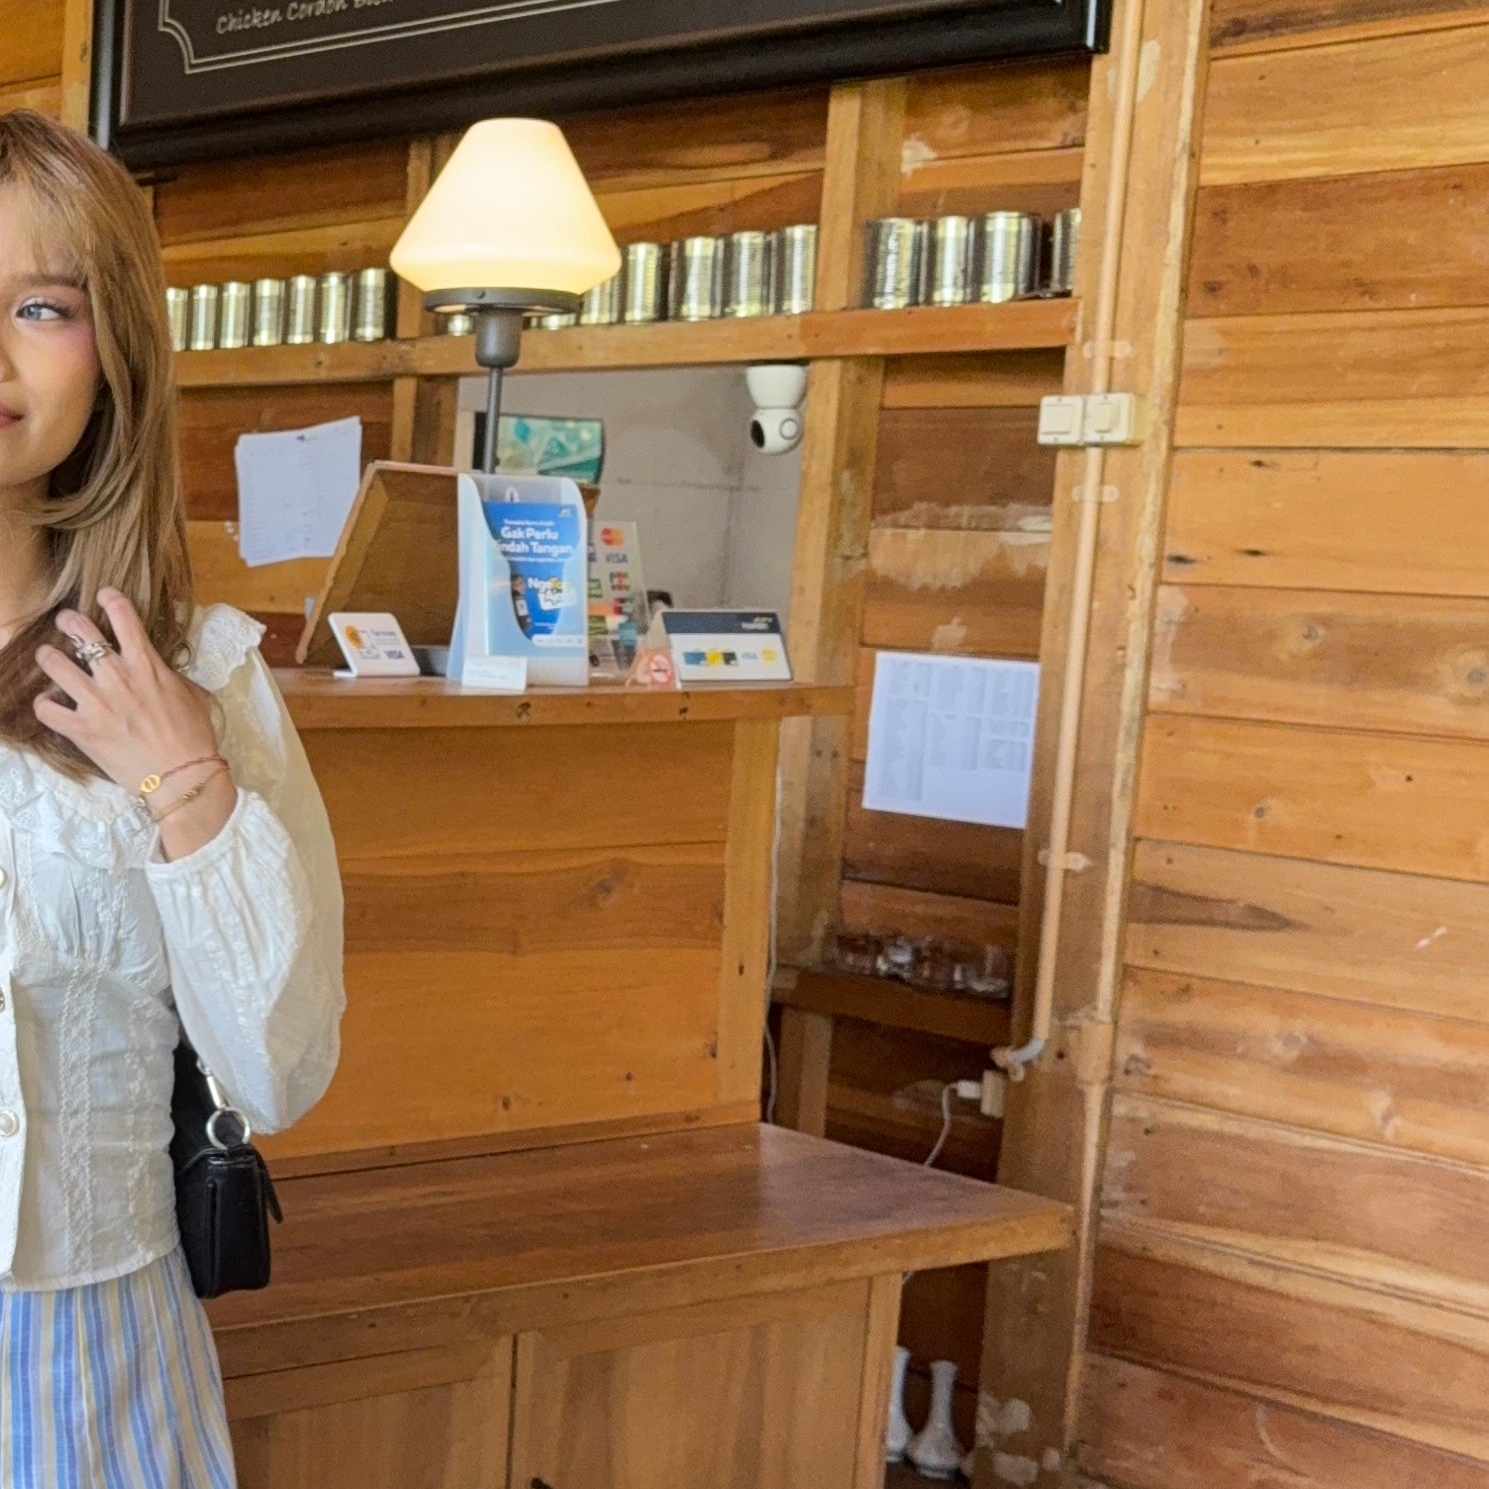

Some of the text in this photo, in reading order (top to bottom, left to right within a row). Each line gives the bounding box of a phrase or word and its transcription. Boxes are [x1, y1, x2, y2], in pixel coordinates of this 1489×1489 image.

[216, 8, 283, 34] Chicken
[500, 526, 560, 541] Gak Perlu
[529, 541, 574, 557] Tangan
